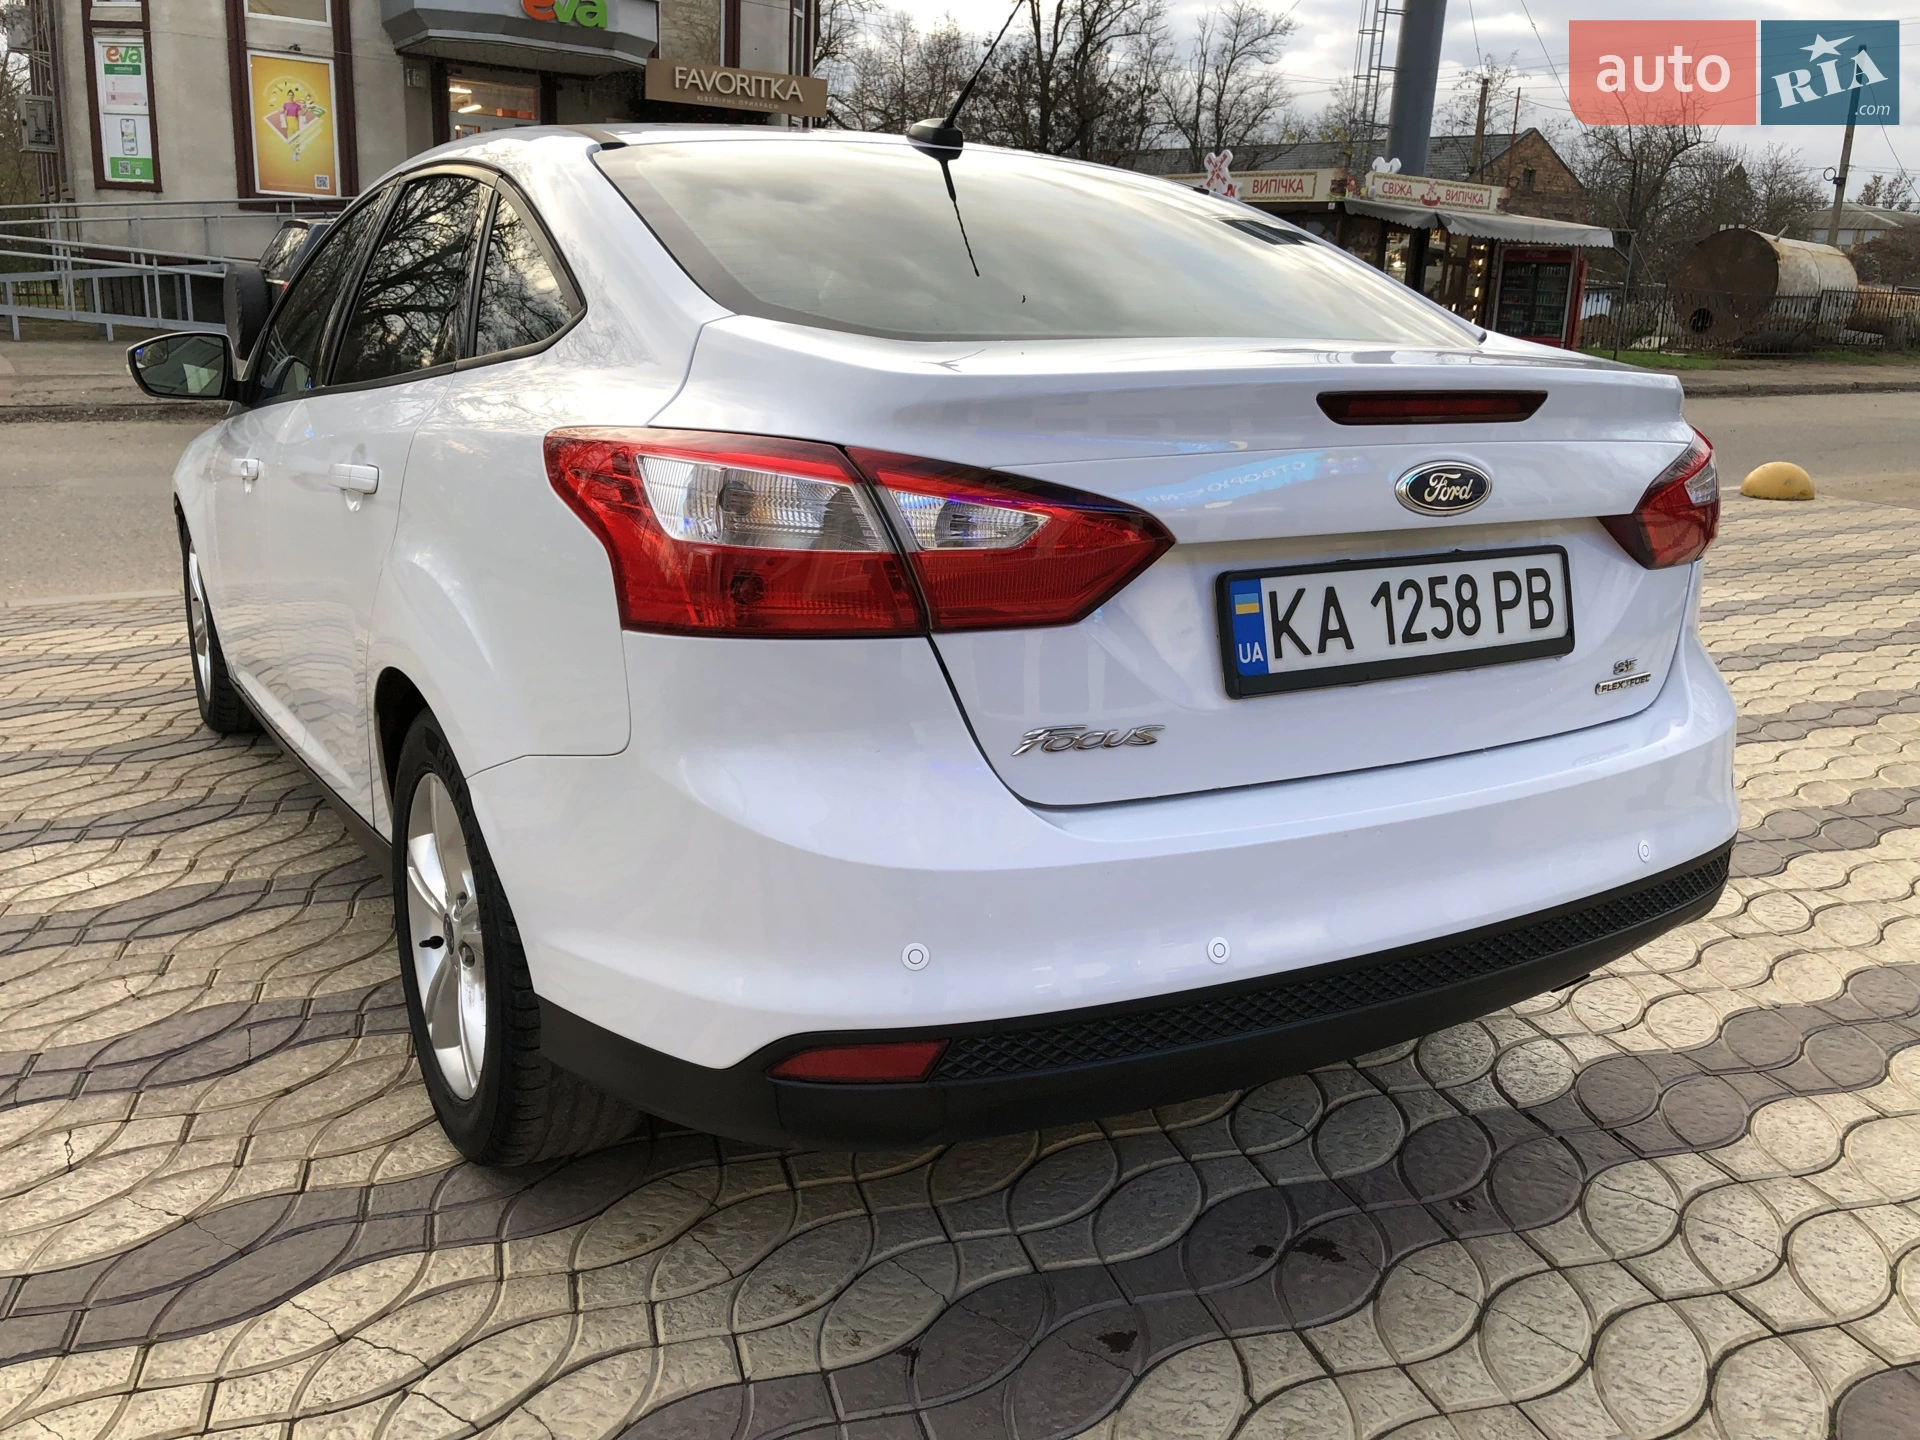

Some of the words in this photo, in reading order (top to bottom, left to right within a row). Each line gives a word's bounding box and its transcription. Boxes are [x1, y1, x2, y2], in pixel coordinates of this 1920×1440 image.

[520, 0, 607, 28] eva
[105, 46, 142, 64] eva
[674, 66, 804, 103] FAVORITKA
[1251, 178, 1304, 194] ВИПІЧКА
[1381, 181, 1413, 197] СВІЖА
[1445, 189, 1484, 205] ВИПІЧКА
[1424, 472, 1474, 503] Ford
[1268, 586, 1355, 660] KA
[1370, 573, 1482, 646] 1258
[1492, 567, 1555, 634] PB
[1237, 641, 1265, 664] UA
[1601, 681, 1624, 693] FLEX
[1629, 674, 1651, 688] FUEL
